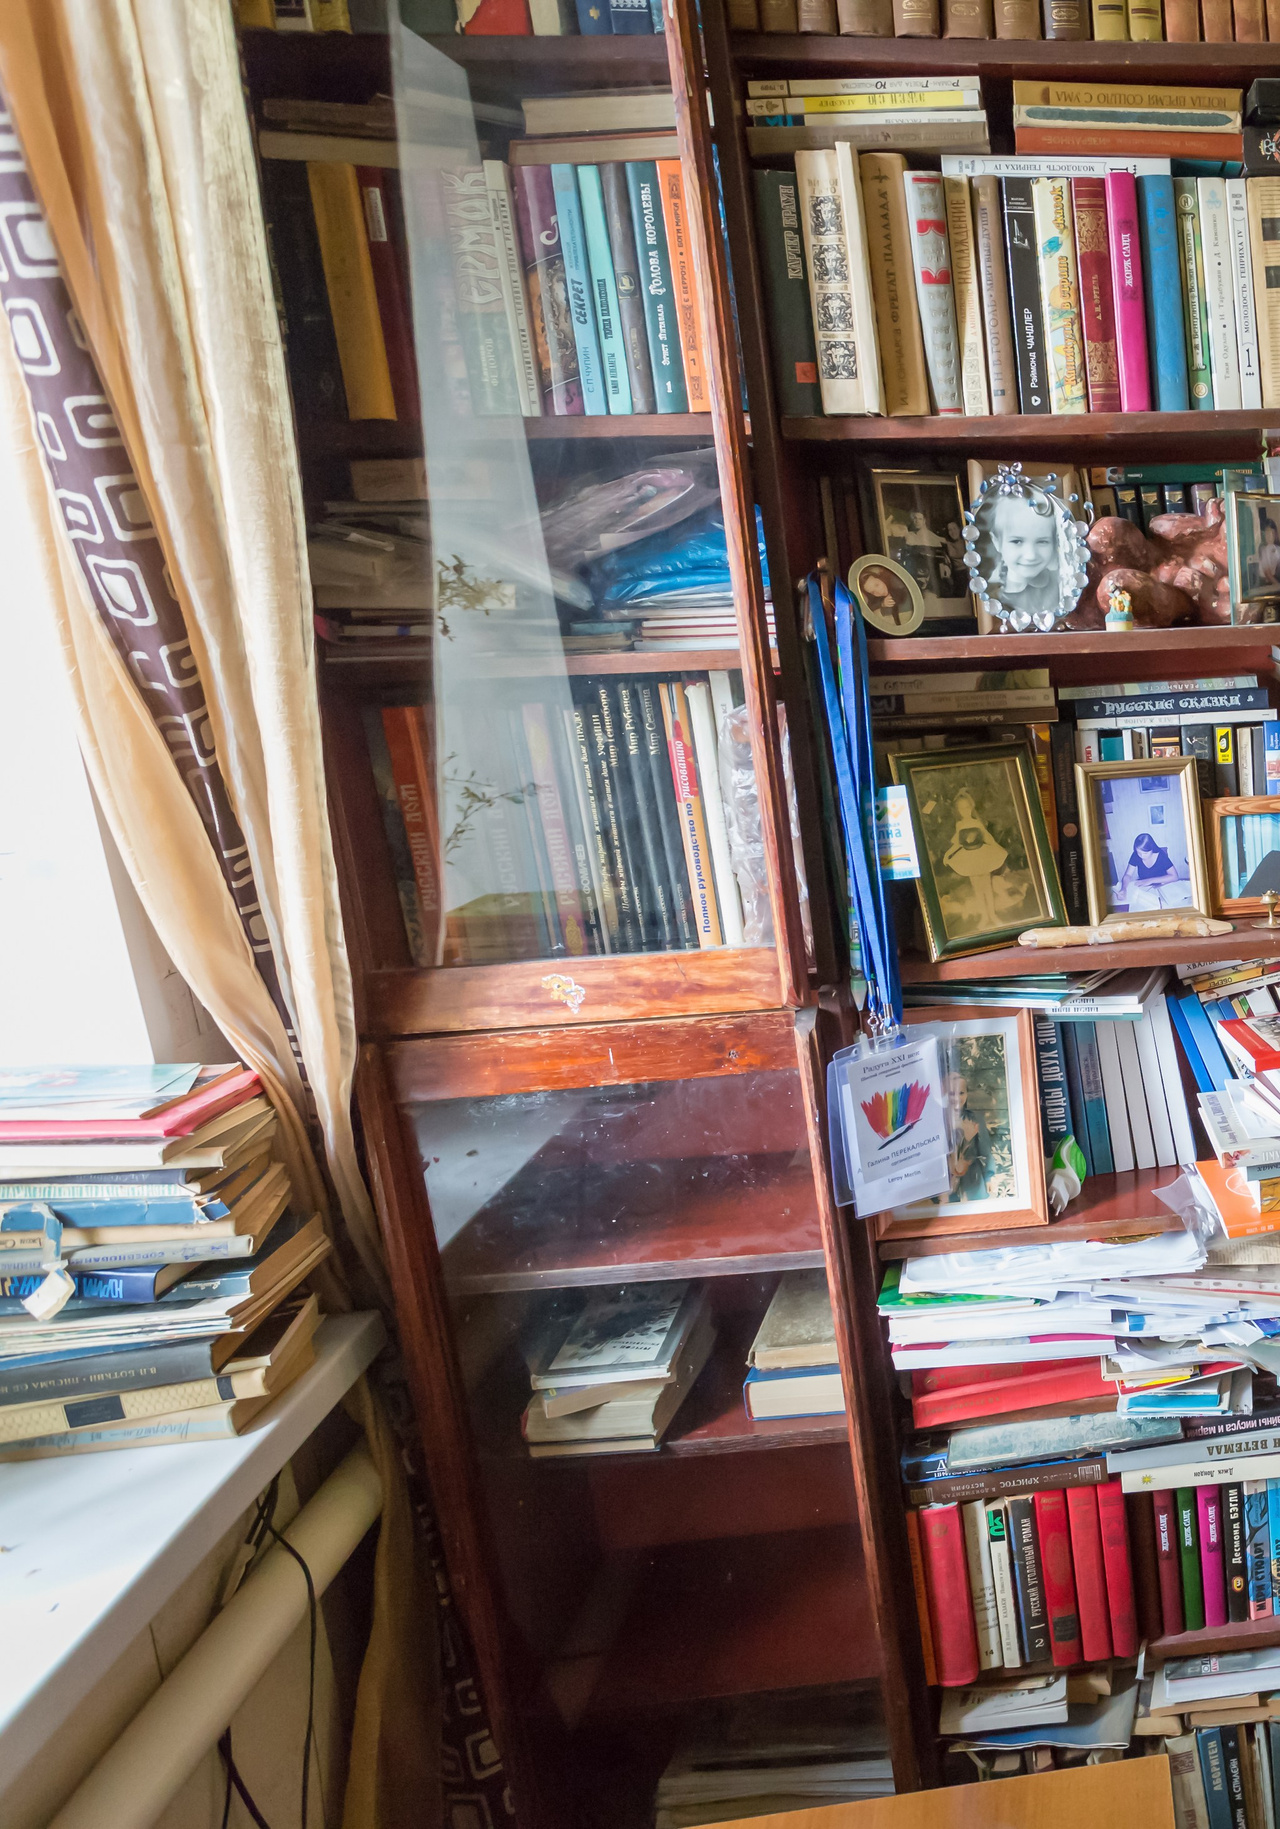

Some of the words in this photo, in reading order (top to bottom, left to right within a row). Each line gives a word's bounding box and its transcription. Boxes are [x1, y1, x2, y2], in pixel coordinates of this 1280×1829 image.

[1055, 91, 1082, 102] УМА
[1097, 93, 1143, 104] СОШЛО
[1147, 94, 1186, 105] ВРЕМЯ
[1046, 164, 1094, 172] МОЛОДОСТЬ
[500, 198, 512, 241] РЕАЛИЗМА
[640, 183, 657, 245] КОРОЛЕВЫ
[672, 202, 681, 227] МАРСА
[779, 185, 798, 228] БРАУН
[1050, 186, 1066, 229] сказок
[980, 207, 991, 241] ДУШИ
[1237, 229, 1245, 238] IV
[785, 231, 803, 279] КАРТЕР
[951, 200, 972, 285] НАСЛАЖДЕНИЕ
[1121, 233, 1131, 257] САНД
[507, 247, 517, 274] ЭПОХИ
[1123, 259, 1134, 287] ЖОРЖ
[1238, 241, 1248, 279] ГЕНРИХА
[512, 279, 523, 316] ЧЕЛОВЕК
[571, 278, 588, 325] СЕКРЕТ
[886, 269, 900, 323] ФРЕГАТ
[1241, 284, 1251, 333] МОЛОДОСТЬ
[987, 299, 1001, 352] ГОГОЛЬ
[1024, 308, 1035, 349] ЧАНДЛЕР
[582, 347, 592, 377] ЧУПИН
[1029, 352, 1038, 388] Рэймонд
[621, 689, 635, 730] Рубенса
[642, 689, 655, 731] Сезанна
[1102, 699, 1174, 715] РУССКИЕ
[1179, 693, 1241, 709] СКАЗКИ
[572, 712, 585, 741] ПРАДО
[591, 714, 605, 756] УФФИЦИ
[628, 733, 640, 755] Мир
[649, 733, 661, 755] Мир
[673, 740, 696, 798] рисованию
[400, 783, 423, 823] ДОМ
[685, 803, 694, 816] по
[574, 844, 591, 894] ФОМИЧЕВ
[687, 819, 707, 890] руководство
[410, 831, 438, 911] РУССКИЙ
[698, 893, 711, 933] Полное
[1209, 977, 1232, 987] ОБЕРЕГ
[863, 1061, 889, 1074] Радуга
[891, 1054, 905, 1064] XXI
[907, 1051, 920, 1059] век
[1039, 1050, 1064, 1081] ДВУХ
[1044, 1088, 1067, 1132] ЭТЮДЫ
[867, 1155, 890, 1168] Галина
[891, 1135, 940, 1159] ПЕРЕКАЛЬСКАЯ
[891, 1152, 921, 1166] организатор
[888, 1174, 903, 1183] Leroy
[904, 1170, 921, 1178] Merlin
[83, 1277, 123, 1298] ЮРИЙ
[31, 1376, 80, 1388] ПИСЬМА
[89, 1369, 135, 1381] БОТКИН
[1206, 1439, 1268, 1456] ВЕТЕМАА
[950, 1482, 984, 1491] ИСТОРИИ
[999, 1476, 1039, 1488] ХРИСТОС
[1194, 1469, 1215, 1478] Лондон
[1217, 1467, 1234, 1476] Джек
[1183, 1509, 1191, 1526] САНД
[1228, 1489, 1239, 1519] БЭГЛИ
[1021, 1518, 1032, 1543] РОМАН
[1159, 1514, 1167, 1531] САНД
[1231, 1522, 1242, 1564] Десмонд
[1023, 1545, 1038, 1585] УГОЛОВНЫЙ
[1254, 1543, 1266, 1580] СТЮАРТ
[1000, 1598, 1008, 1618] КАЗАКИ
[1028, 1587, 1041, 1617] РУССКИЙ
[1256, 1585, 1266, 1611] МЕРИ
[1207, 1740, 1223, 1791] АБОРИГЕН
[1229, 1758, 1241, 1793] СПИЛЕЙН
